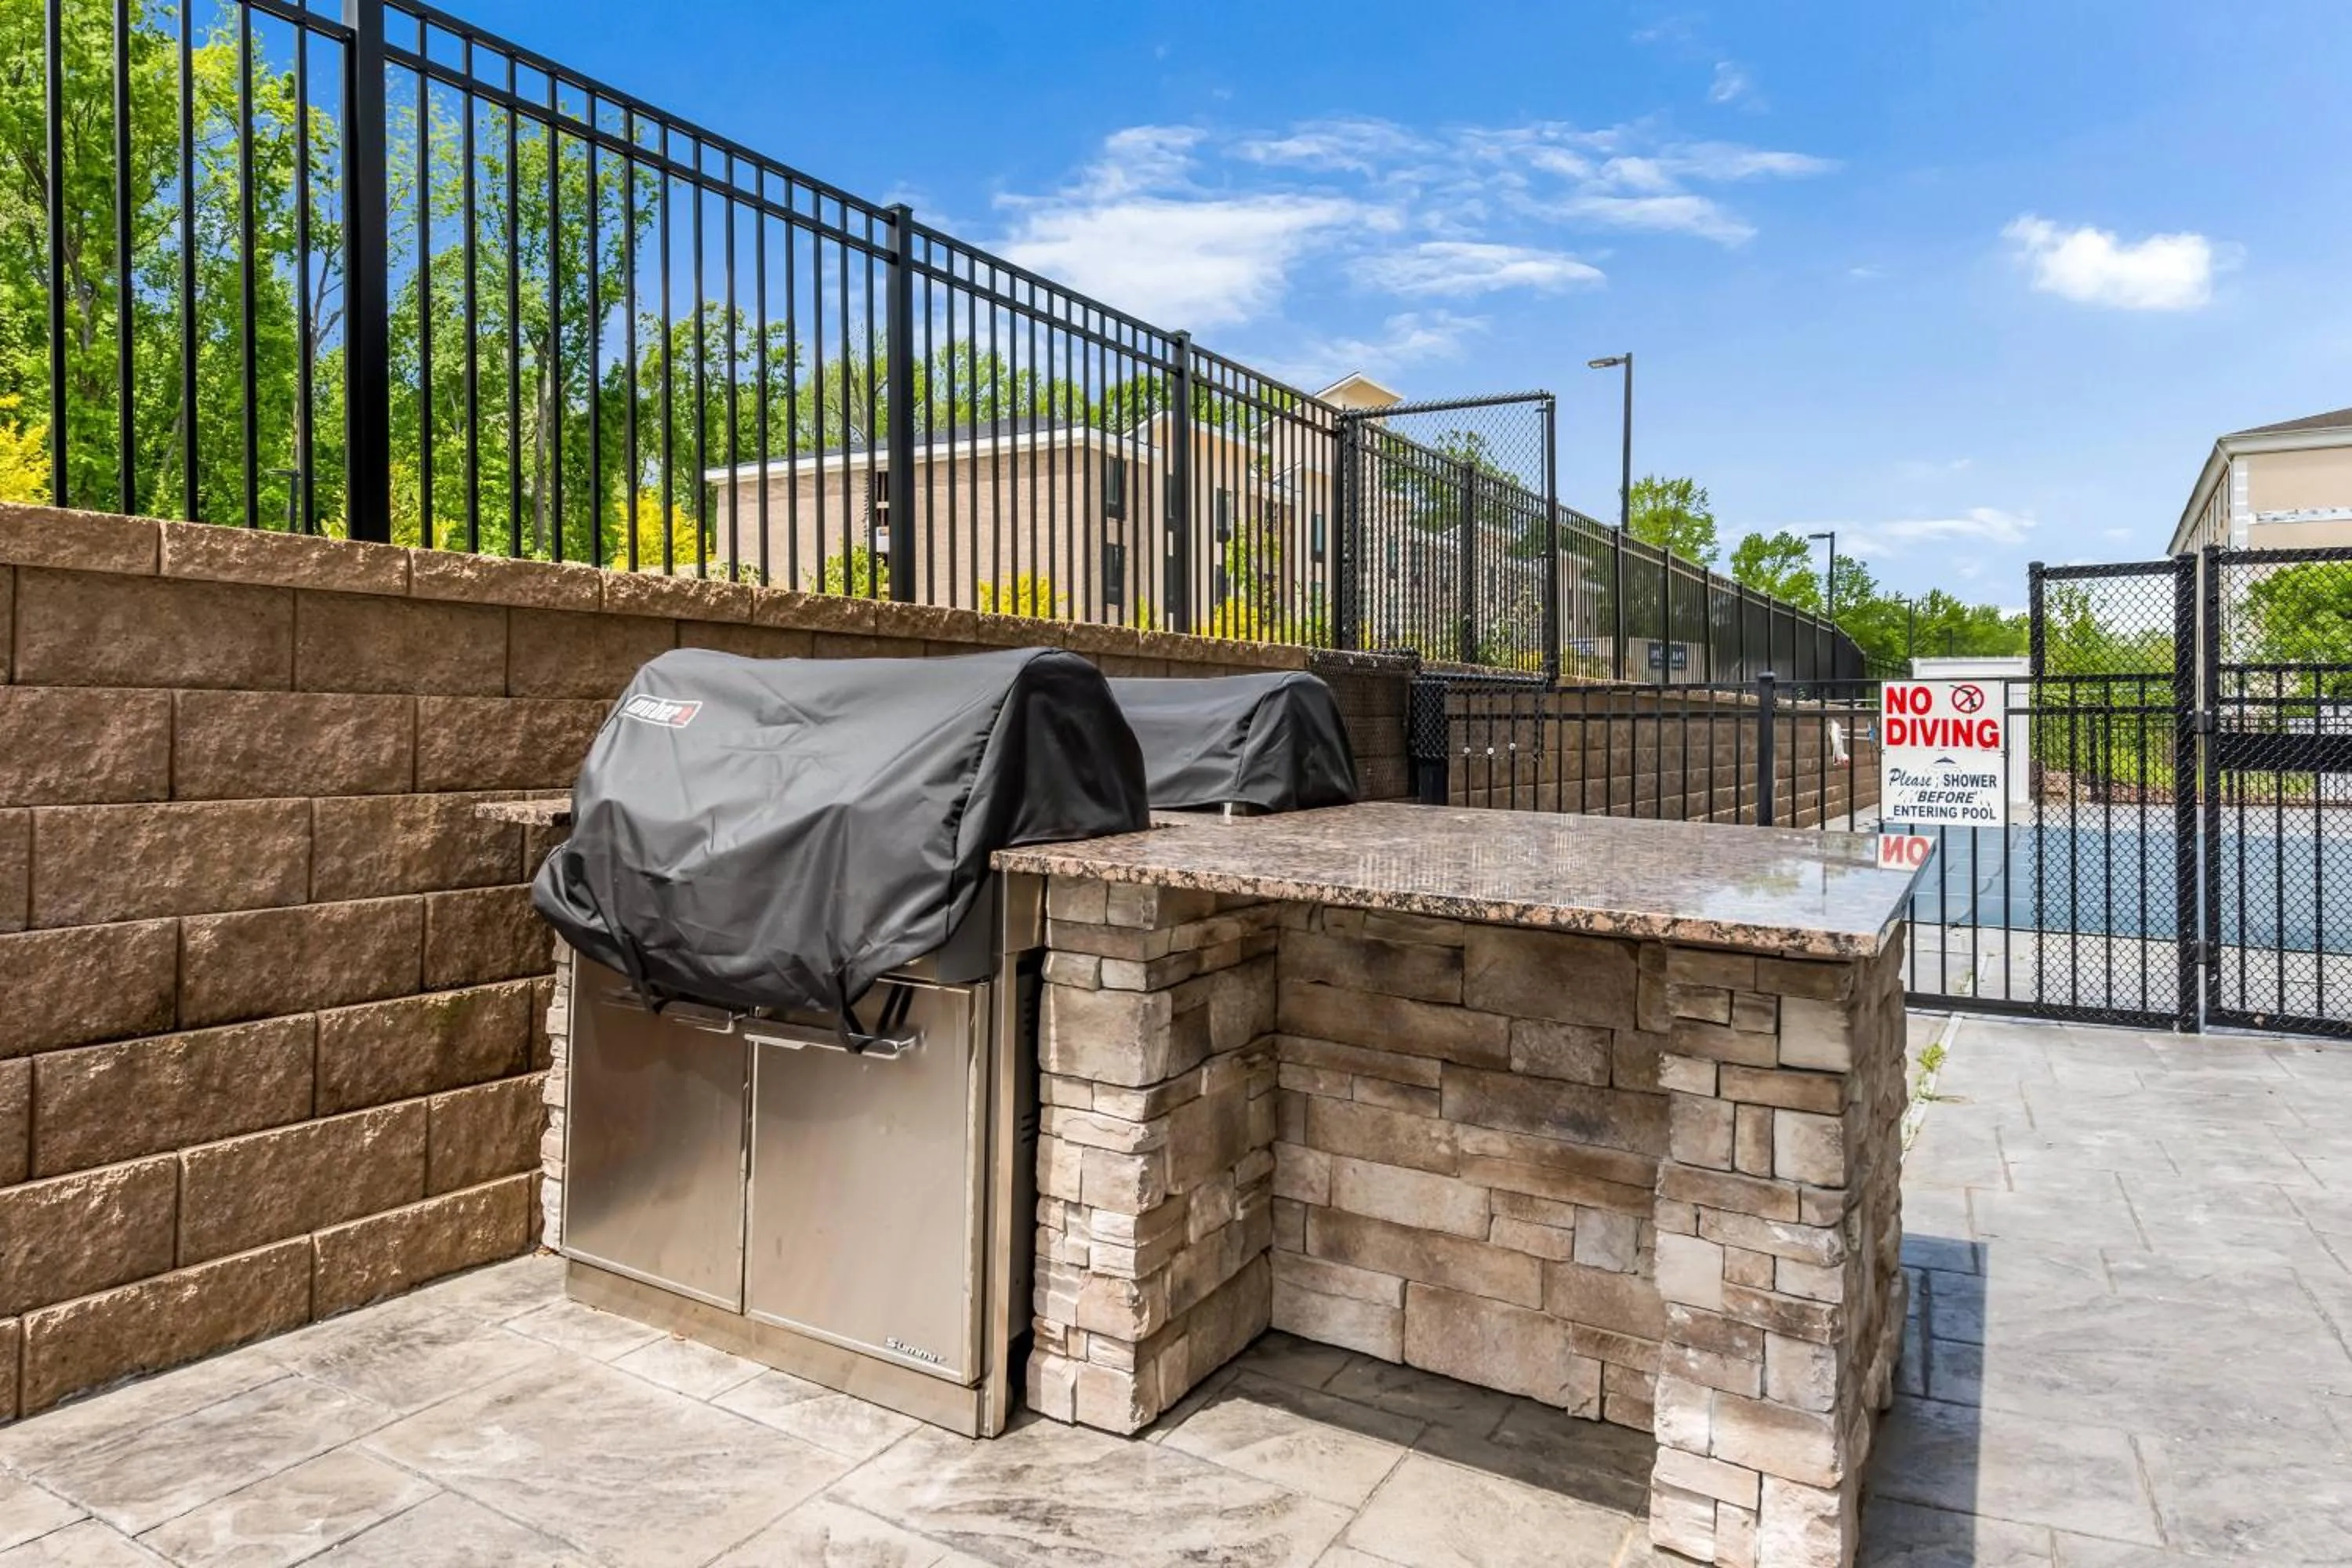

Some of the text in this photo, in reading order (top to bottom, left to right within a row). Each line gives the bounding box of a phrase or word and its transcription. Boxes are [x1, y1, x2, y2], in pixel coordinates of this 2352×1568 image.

[1886, 686, 1933, 715] NO
[1886, 718, 2000, 749] DIVING
[1889, 768, 1997, 788] Please SHOWER
[1918, 790, 1976, 804] BEFORE
[1893, 805, 1997, 819] ENTERING POOL
